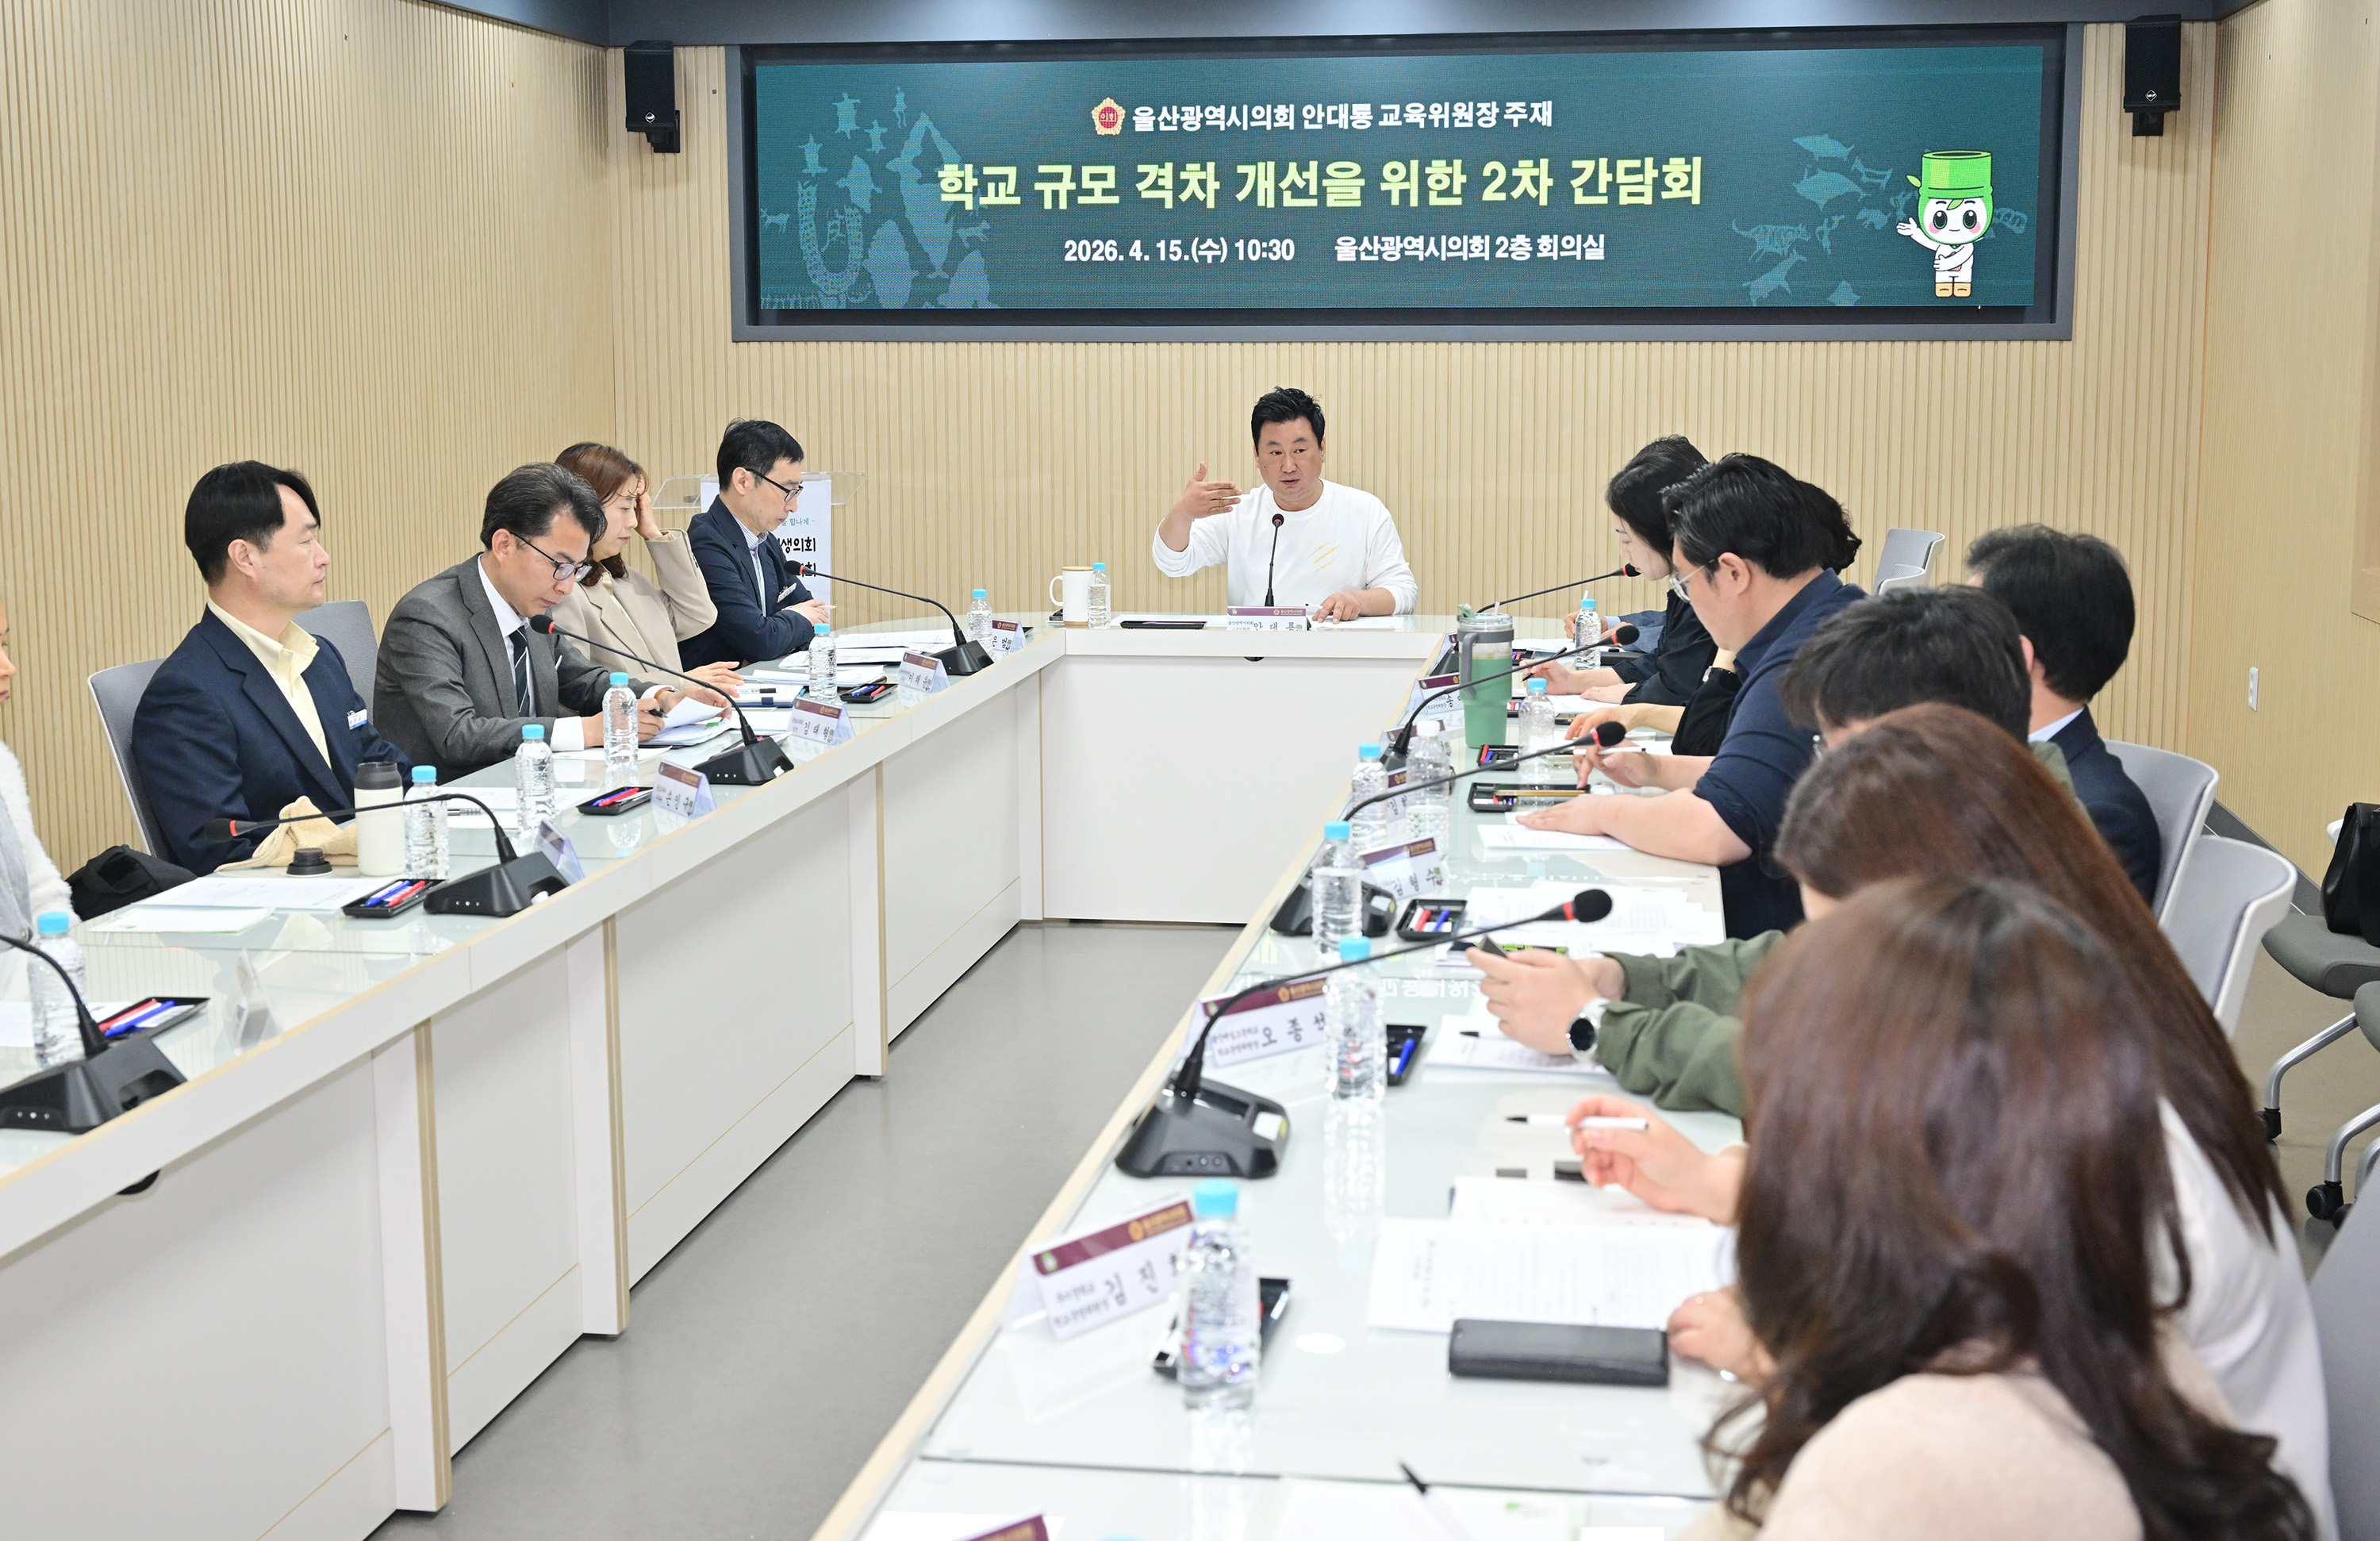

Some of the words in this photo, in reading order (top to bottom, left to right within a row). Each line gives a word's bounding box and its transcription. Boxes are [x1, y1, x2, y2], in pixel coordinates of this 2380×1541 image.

[1100, 112, 1117, 122] 의회
[1132, 105, 1295, 132] 울산광역시의회
[1302, 103, 1372, 129] 안대룡
[1378, 102, 1499, 129] 교육위원장
[1504, 100, 1553, 128] 주재
[937, 163, 1021, 210] 학교
[1034, 164, 1119, 209] 규모
[1135, 162, 1220, 209] 격차
[1235, 161, 1365, 208] 개선을
[1380, 159, 1467, 207] 위한
[1482, 159, 1553, 206] 2차
[1570, 157, 1702, 206] 간담회
[1064, 240, 1124, 262] 2026.
[1129, 240, 1150, 261] 4.
[1156, 237, 1228, 263] 15.(수)
[1234, 239, 1295, 261] 10:30
[1334, 236, 1490, 262] 울산광역시의회
[1495, 235, 1533, 261] 2층
[1537, 234, 1605, 261] 회의실
[789, 517, 809, 527] 힘나게
[777, 536, 816, 554] 생의회
